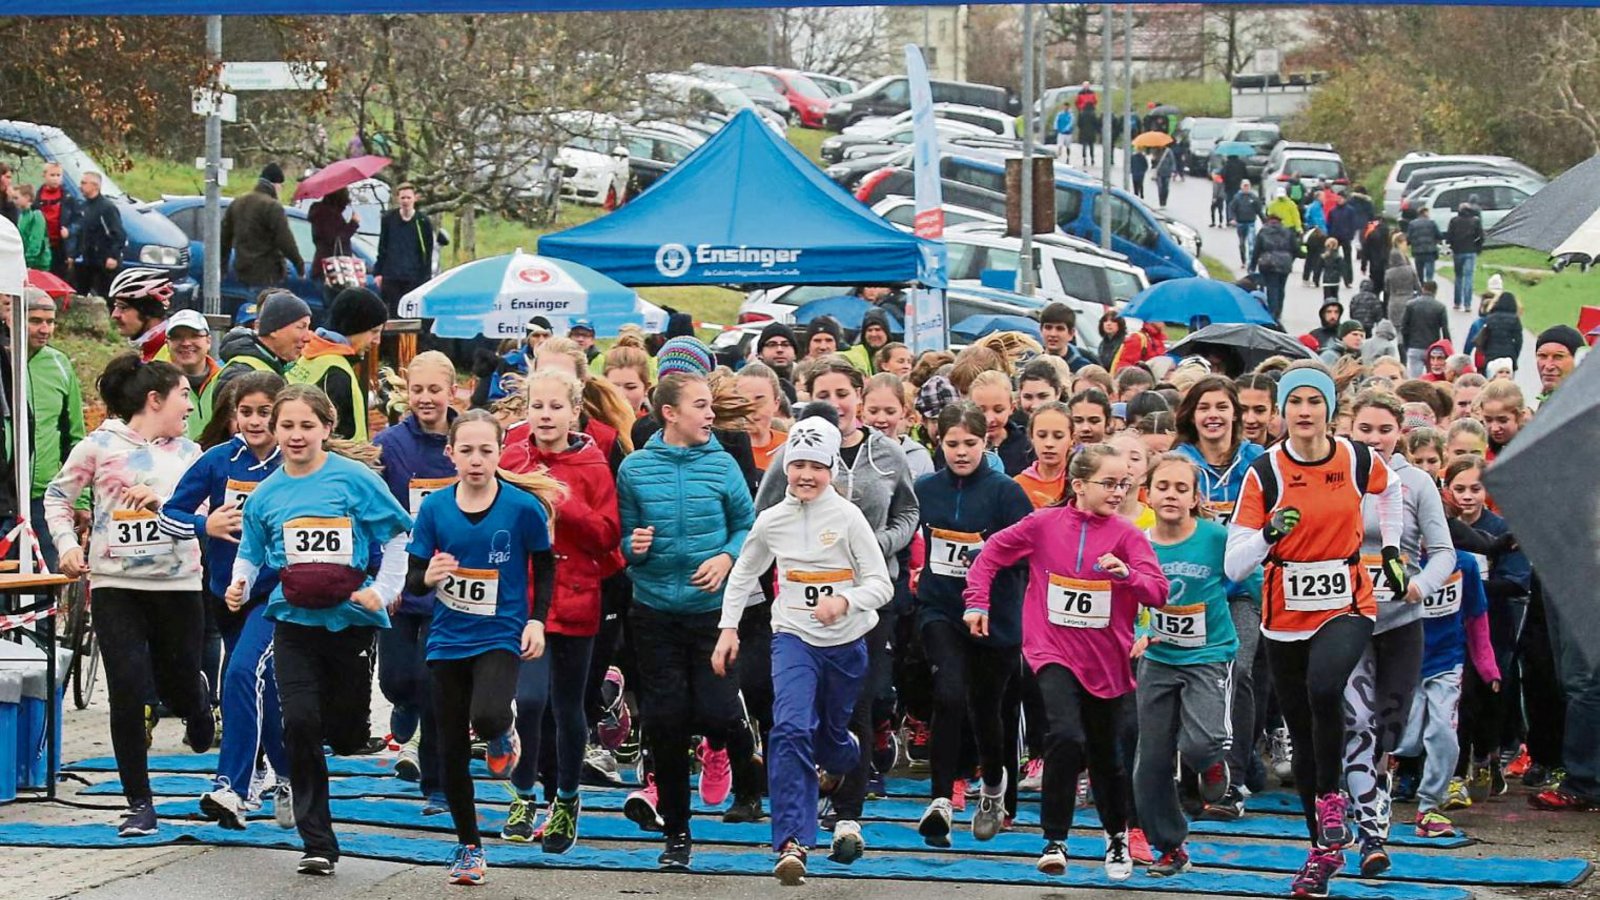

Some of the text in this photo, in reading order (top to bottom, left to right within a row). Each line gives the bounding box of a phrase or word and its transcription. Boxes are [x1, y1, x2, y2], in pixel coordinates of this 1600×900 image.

[696, 244, 801, 267] Ensinger
[511, 299, 570, 311] Ensinger
[118, 521, 160, 544] 312
[296, 531, 341, 552] 326
[444, 575, 485, 601] 216
[1288, 573, 1346, 596] 1239
[1063, 591, 1092, 614] 76
[1155, 613, 1194, 635] 152
